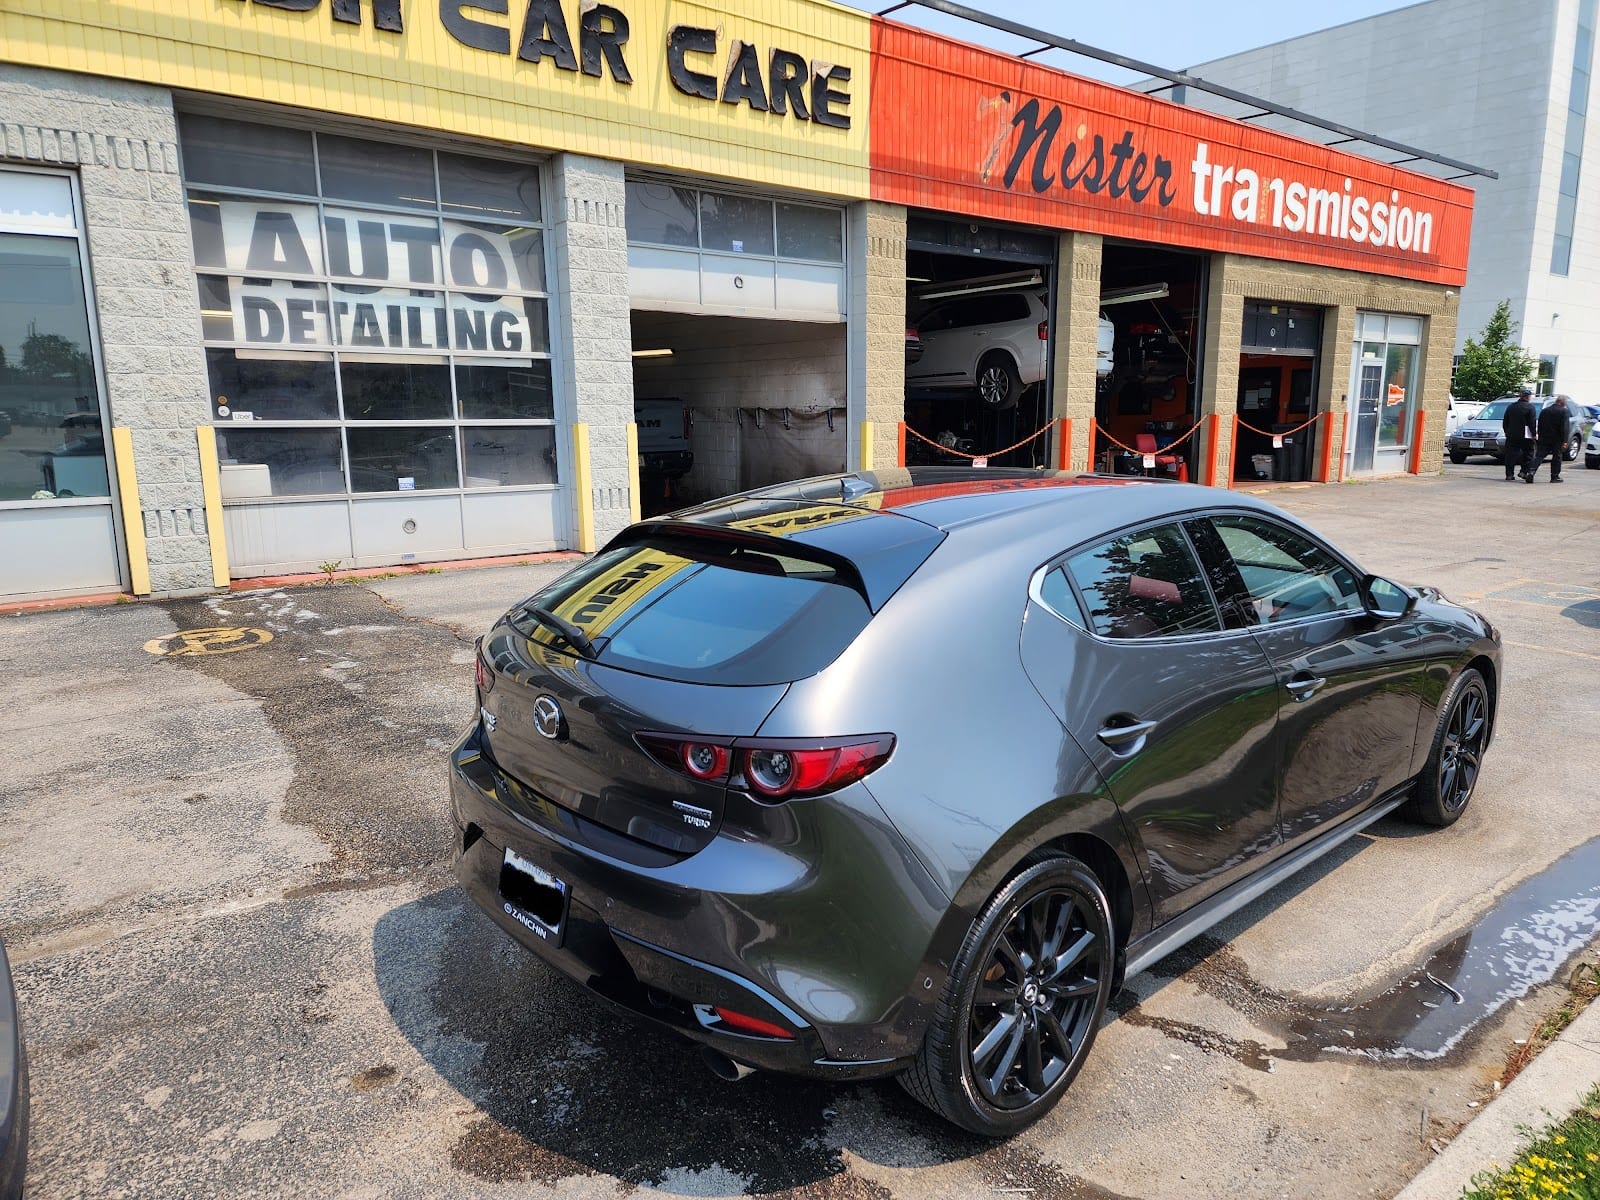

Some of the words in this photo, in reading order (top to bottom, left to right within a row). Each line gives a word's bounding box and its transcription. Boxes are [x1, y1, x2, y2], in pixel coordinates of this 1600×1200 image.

[440, 0, 634, 85] CAR
[667, 22, 852, 129] CARE
[981, 91, 1177, 207] Mister
[1191, 143, 1433, 254] transmission
[242, 210, 508, 302] AUTO
[241, 295, 523, 353] DETAILING
[682, 814, 711, 828] TURBO
[510, 908, 548, 939] ZANCHIN
